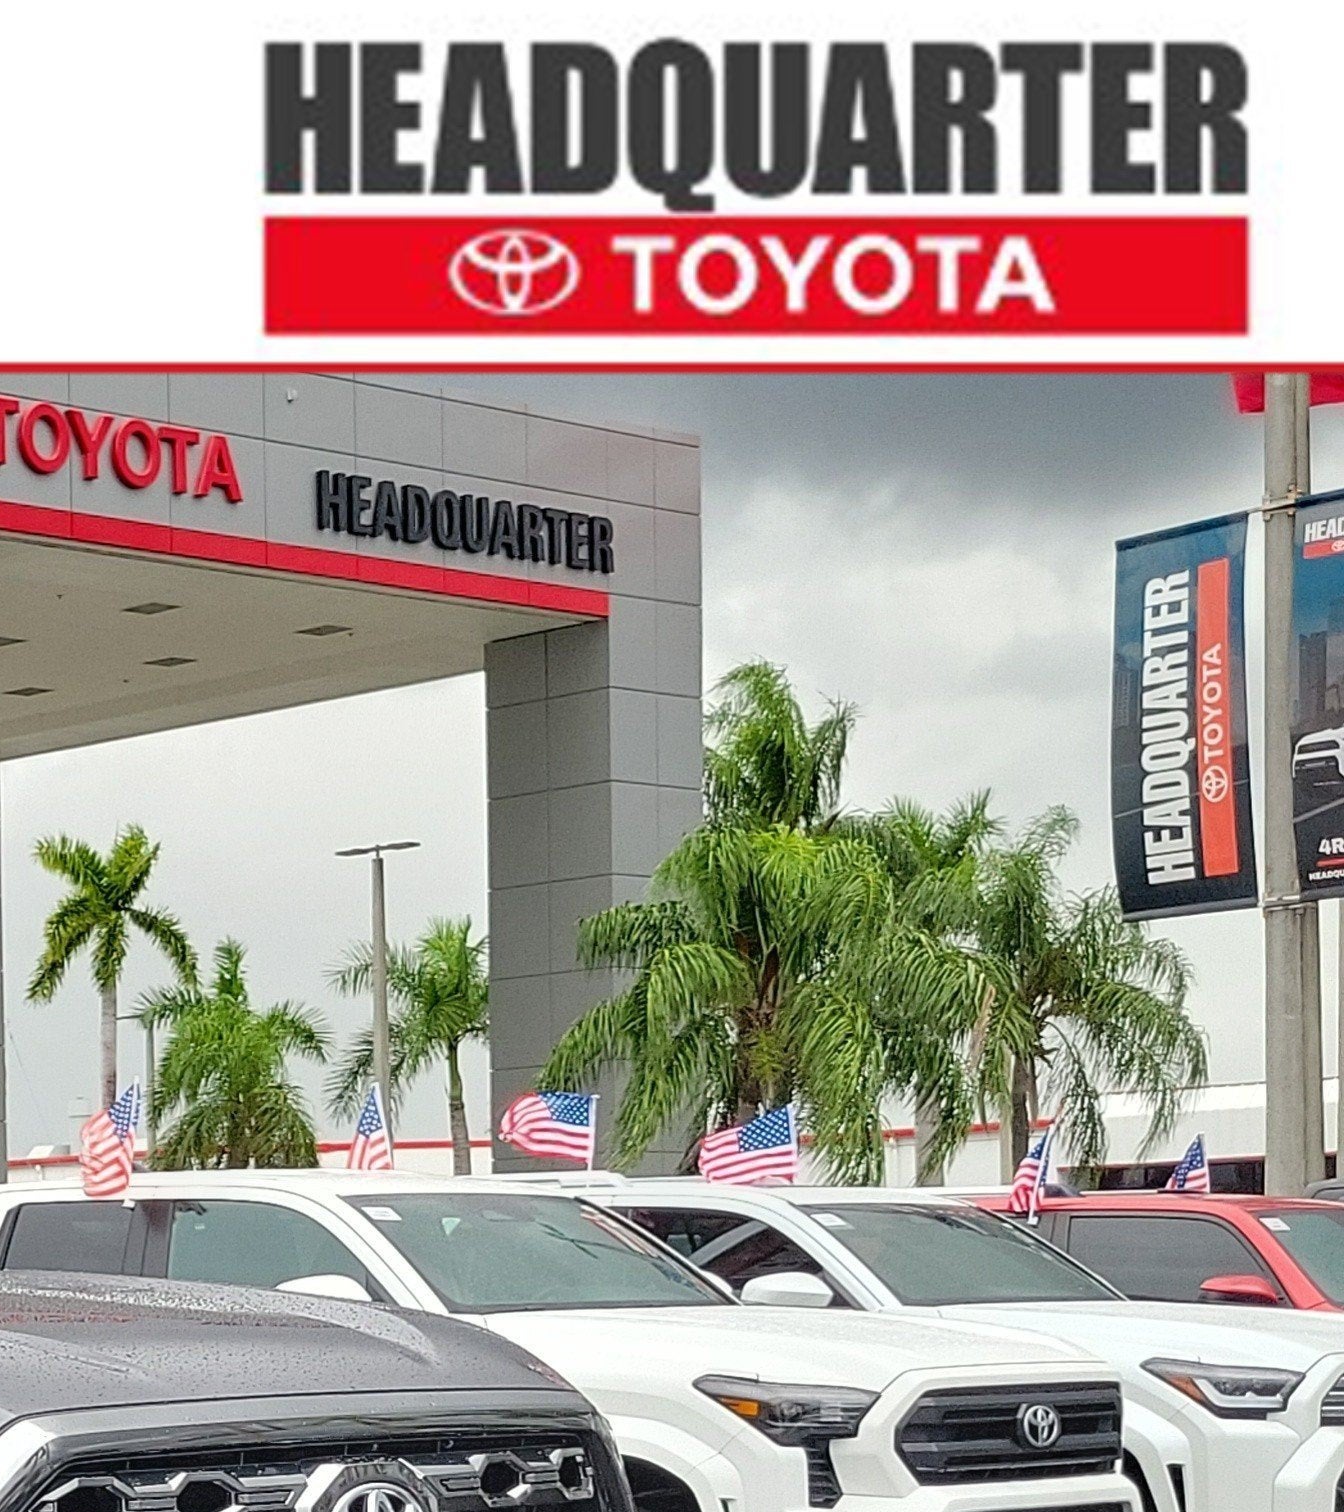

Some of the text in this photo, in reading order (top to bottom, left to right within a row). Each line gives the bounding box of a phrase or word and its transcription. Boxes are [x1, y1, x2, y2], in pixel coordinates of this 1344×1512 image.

[315, 470, 615, 574] HEADQUARTER
[1140, 569, 1196, 885] HEADQUARTER
[1202, 642, 1223, 764] TOYOTA
